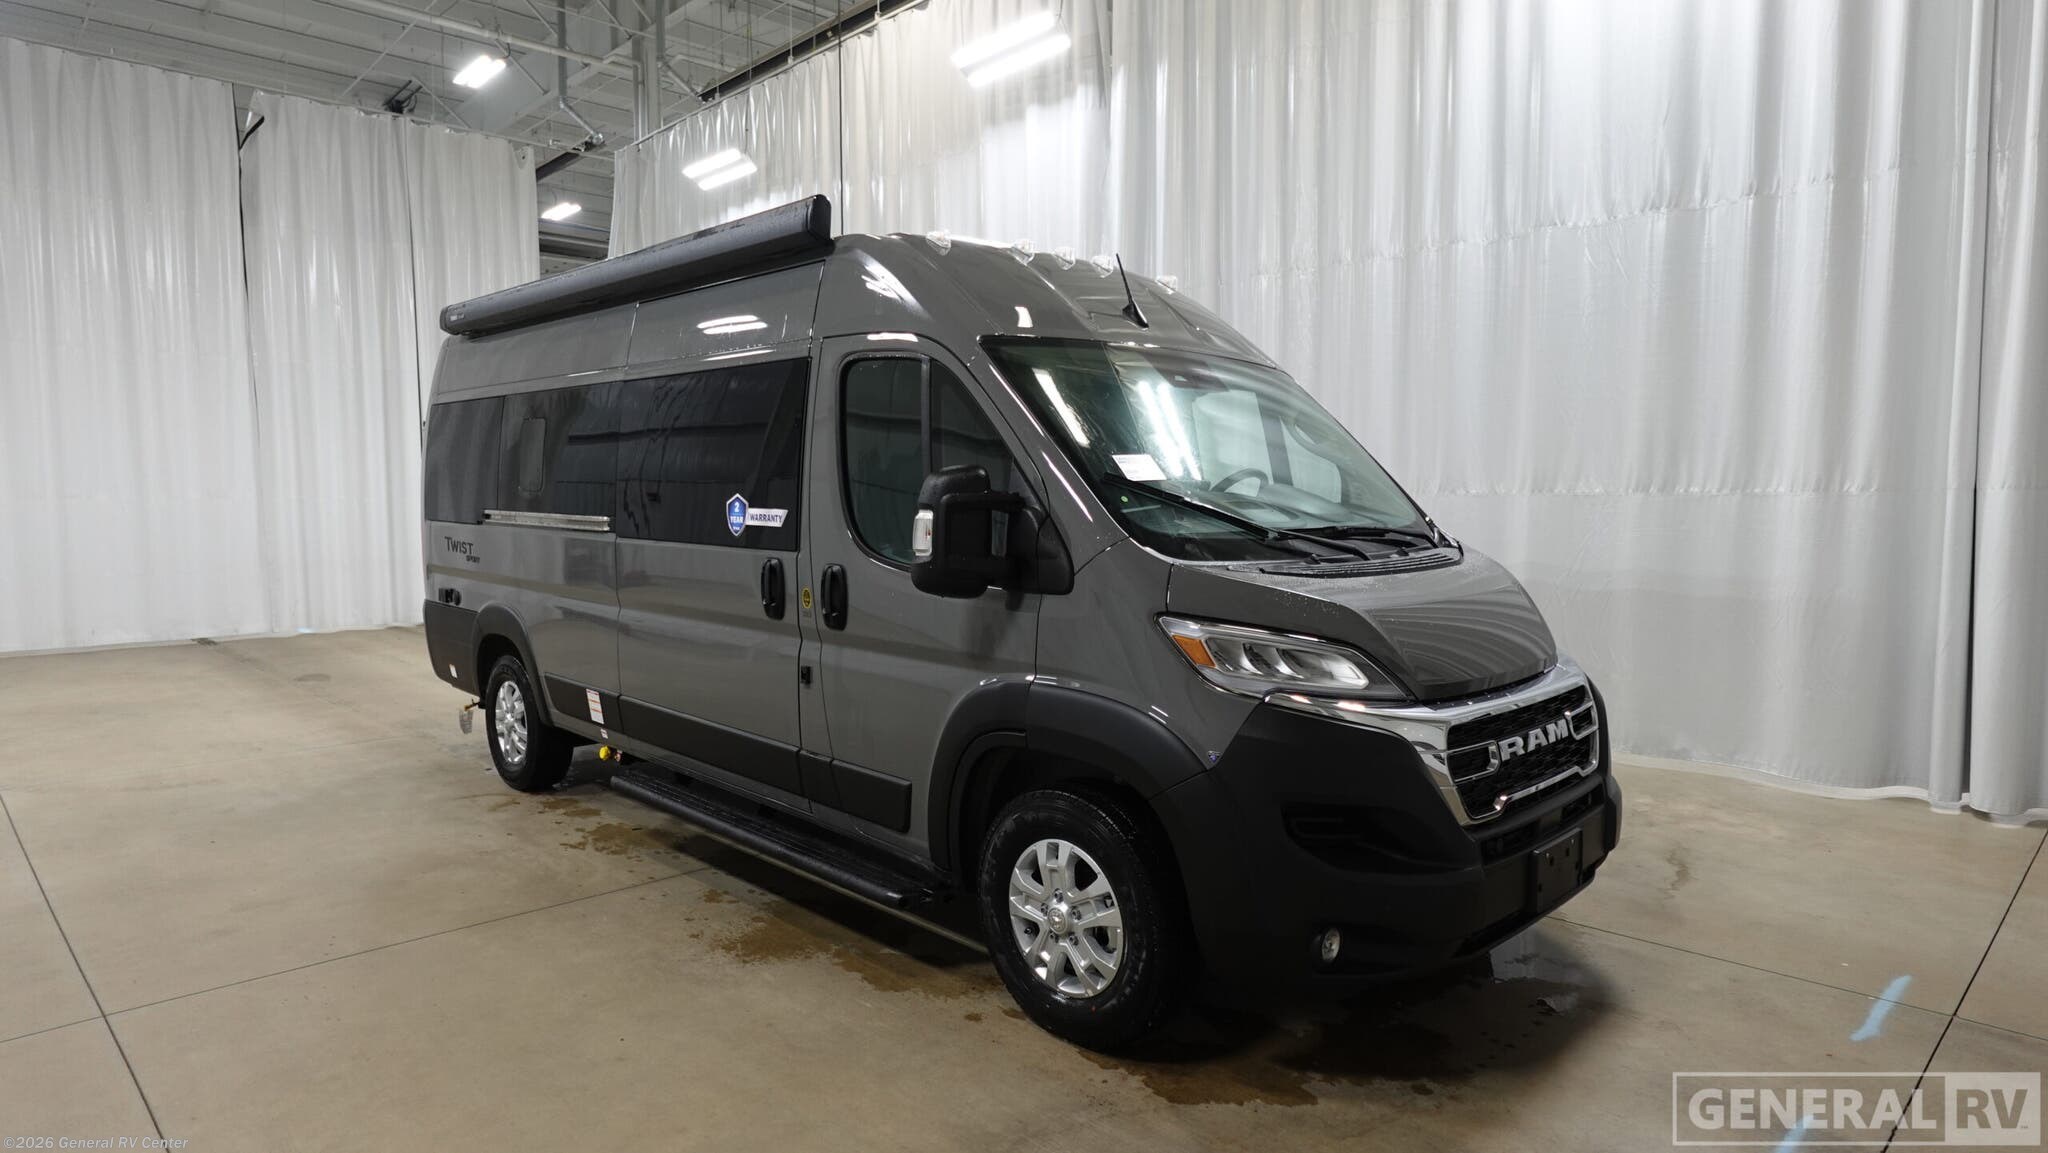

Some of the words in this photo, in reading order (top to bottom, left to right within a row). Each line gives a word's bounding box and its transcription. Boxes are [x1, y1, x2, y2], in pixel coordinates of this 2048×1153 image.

[734, 501, 740, 513] 2
[730, 516, 744, 524] YEAR
[750, 513, 782, 523] WARRANTY
[444, 536, 474, 555] TWIST
[1498, 719, 1569, 762] RAM
